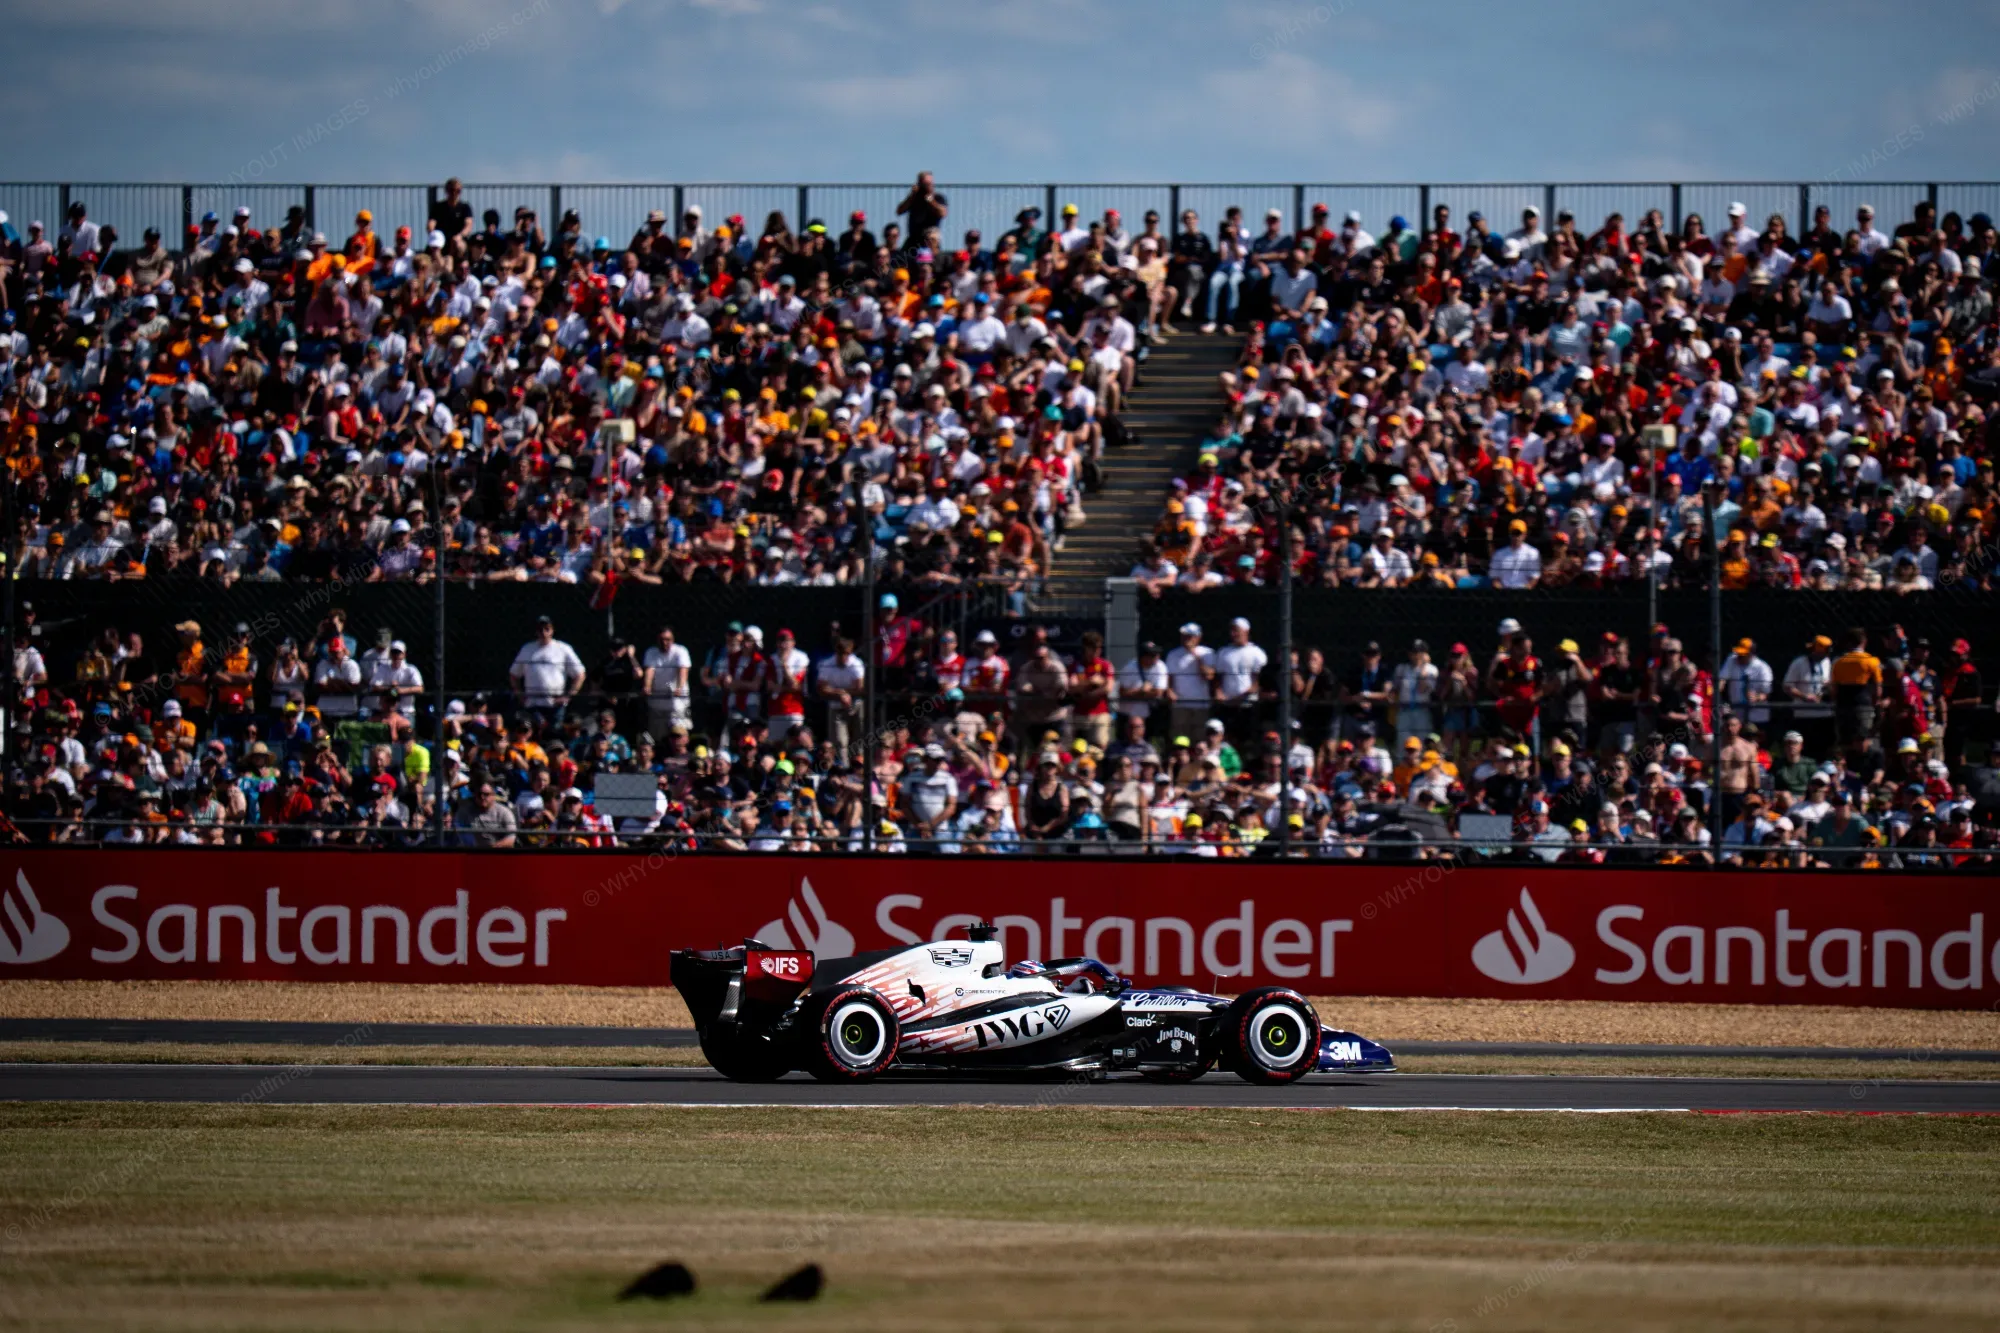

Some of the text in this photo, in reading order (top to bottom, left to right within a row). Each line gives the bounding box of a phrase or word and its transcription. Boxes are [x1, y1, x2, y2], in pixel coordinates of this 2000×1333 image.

[90, 884, 567, 967] Santander
[711, 951, 732, 960] USA
[1595, 904, 2000, 990] Santand
[775, 957, 800, 974] IFS
[1130, 992, 1188, 1007] Cadillac
[965, 1010, 1045, 1048] TWG
[1127, 1016, 1153, 1027] Claro
[1157, 1027, 1196, 1045] JIM BEAM
[1328, 1041, 1362, 1060] 3M
